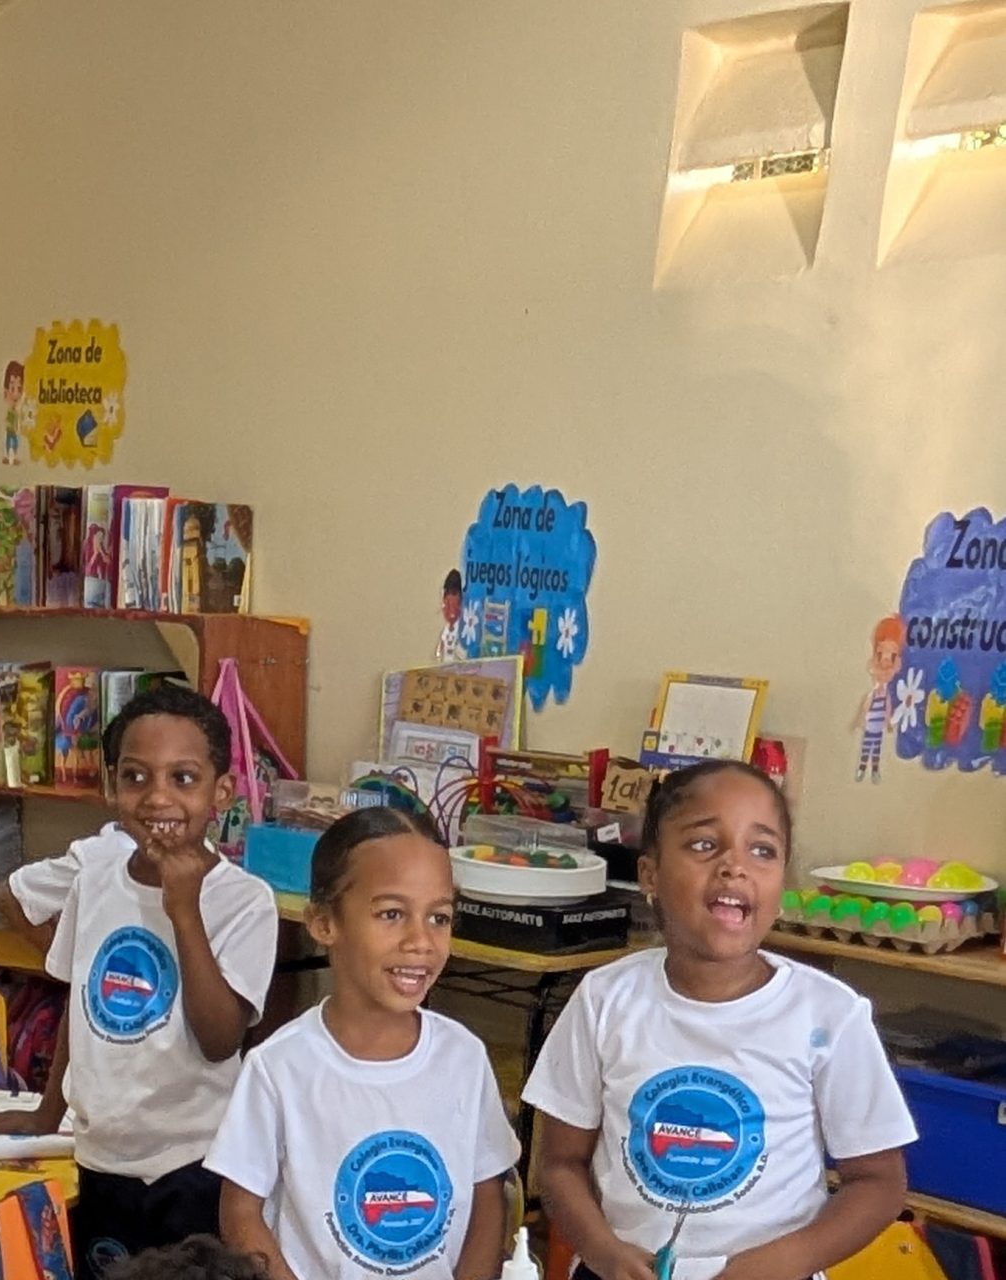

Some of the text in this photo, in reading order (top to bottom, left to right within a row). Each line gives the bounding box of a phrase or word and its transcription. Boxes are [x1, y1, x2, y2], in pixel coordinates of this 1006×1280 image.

[46, 336, 103, 365] Zona de
[38, 378, 103, 405] biblioteca
[493, 491, 556, 532] Zona de
[463, 548, 569, 601] juegos lógicos
[645, 1072, 751, 1114] Colegio Evangélico
[657, 1126, 702, 1139] AVANCE
[369, 1192, 408, 1203] AVANCE
